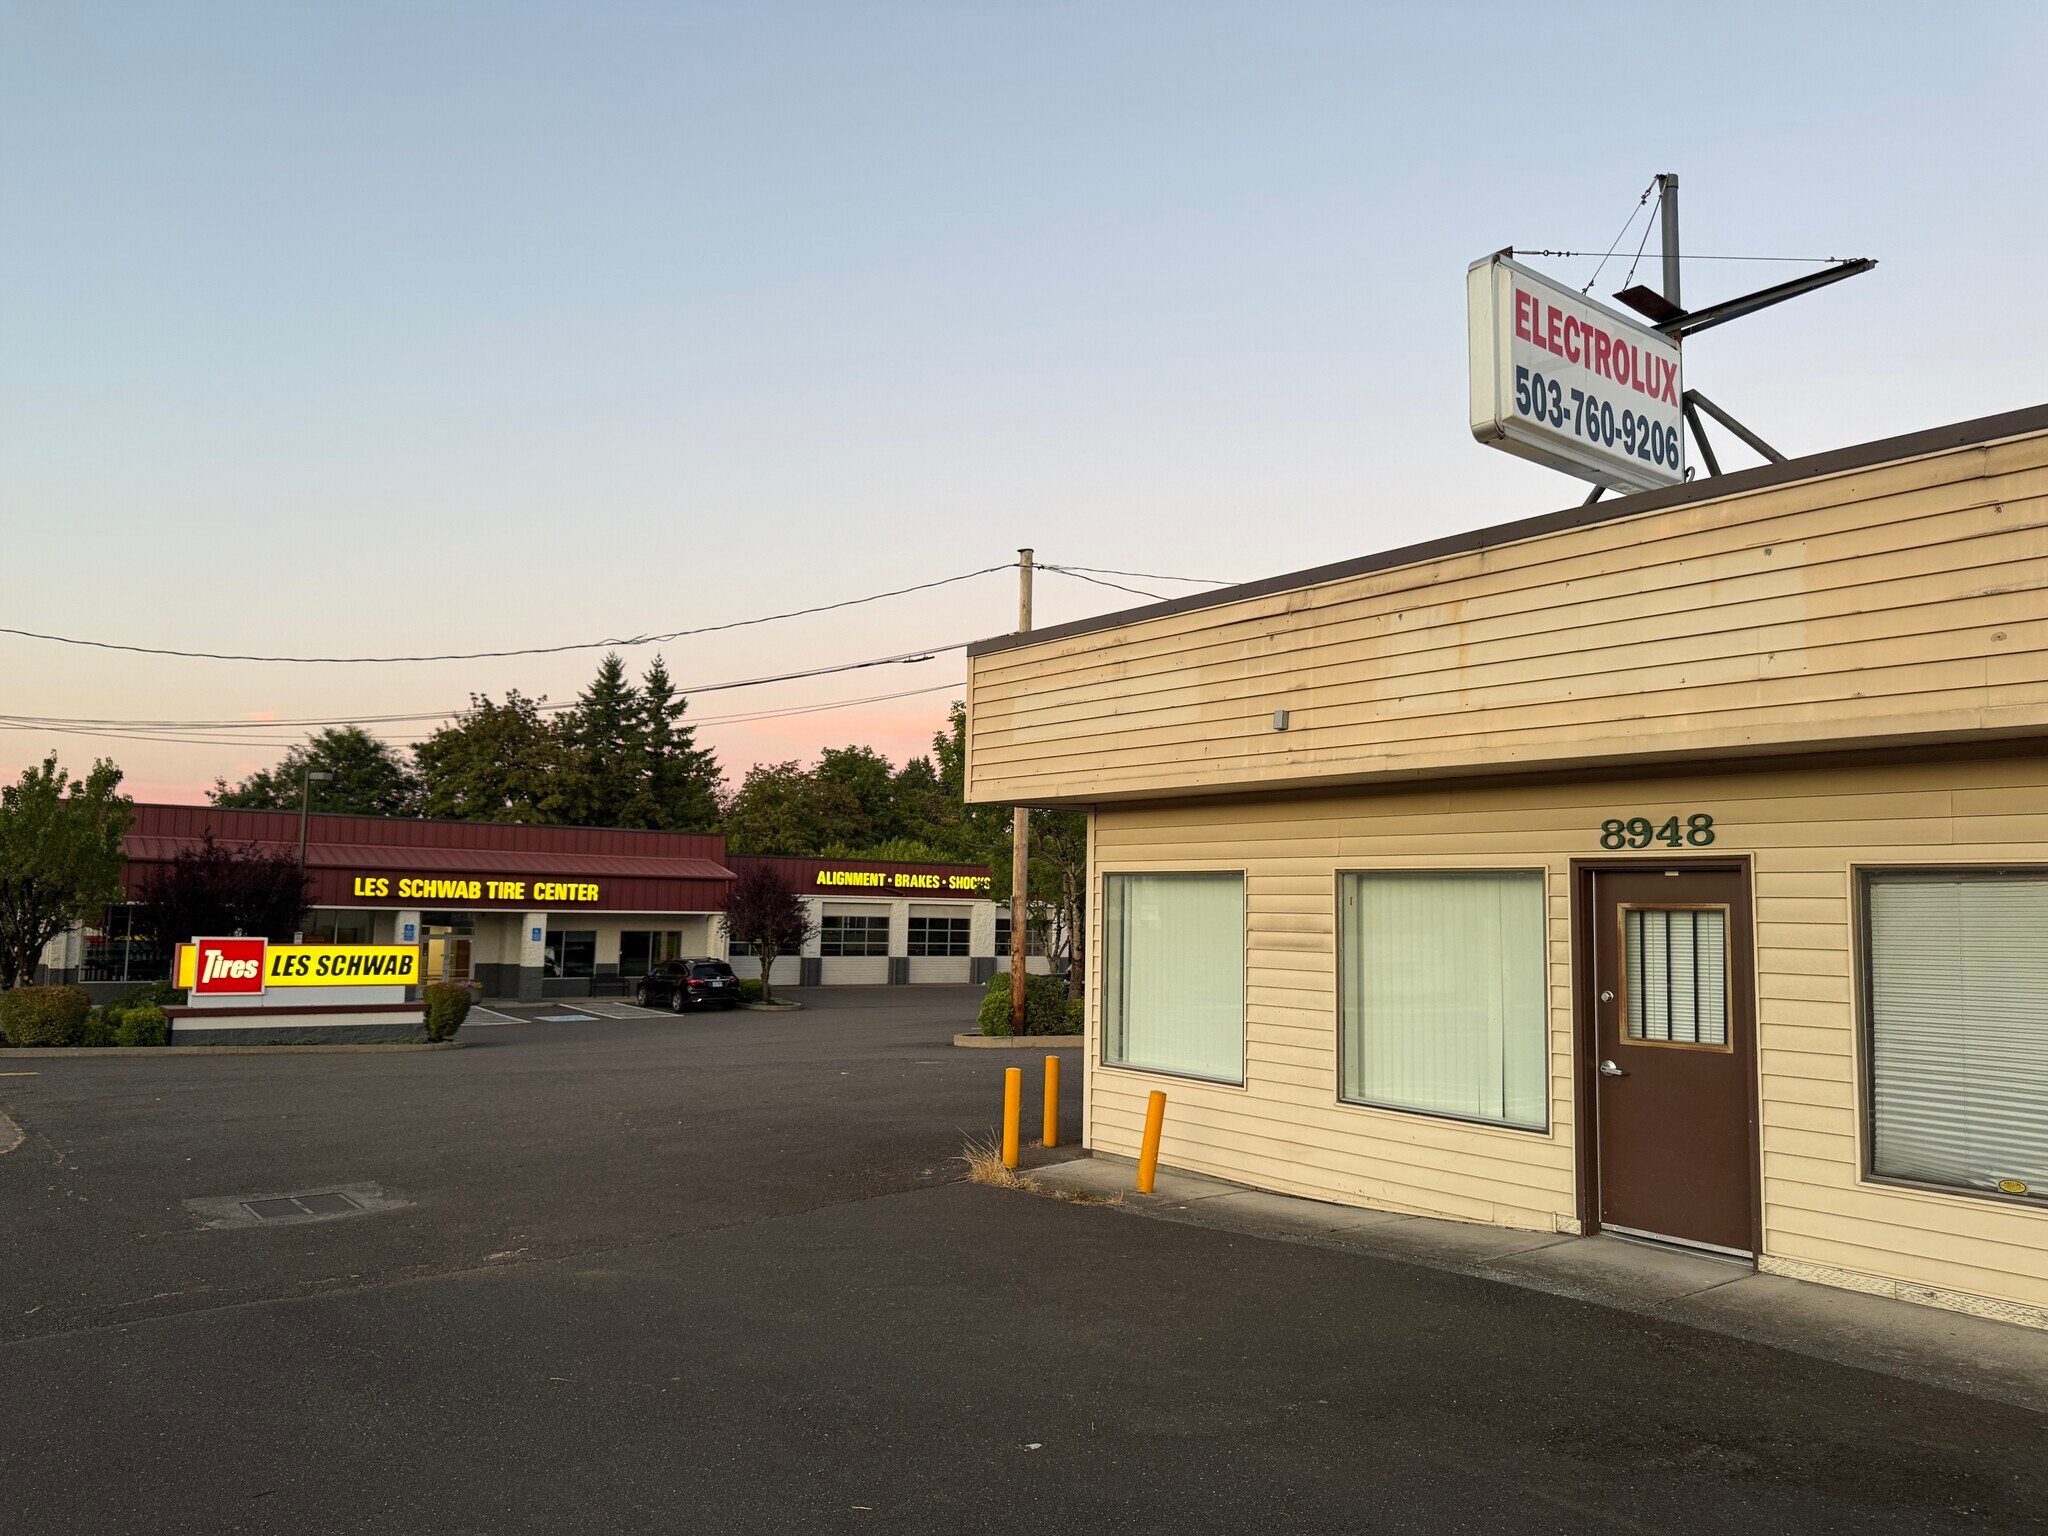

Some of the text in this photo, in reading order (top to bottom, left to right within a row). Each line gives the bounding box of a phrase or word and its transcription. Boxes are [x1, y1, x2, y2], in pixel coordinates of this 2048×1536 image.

[1515, 288, 1678, 408] ELECTROLUX
[1515, 364, 1679, 471] 503-760-9206
[1600, 813, 1715, 849] 8948
[354, 877, 599, 901] LES SCHWAB TIRE CENTER
[816, 870, 886, 887] ALIGNMENT
[894, 873, 940, 888] BRAKES
[201, 949, 260, 984] Tires
[271, 955, 414, 977] LES SCHWAB
